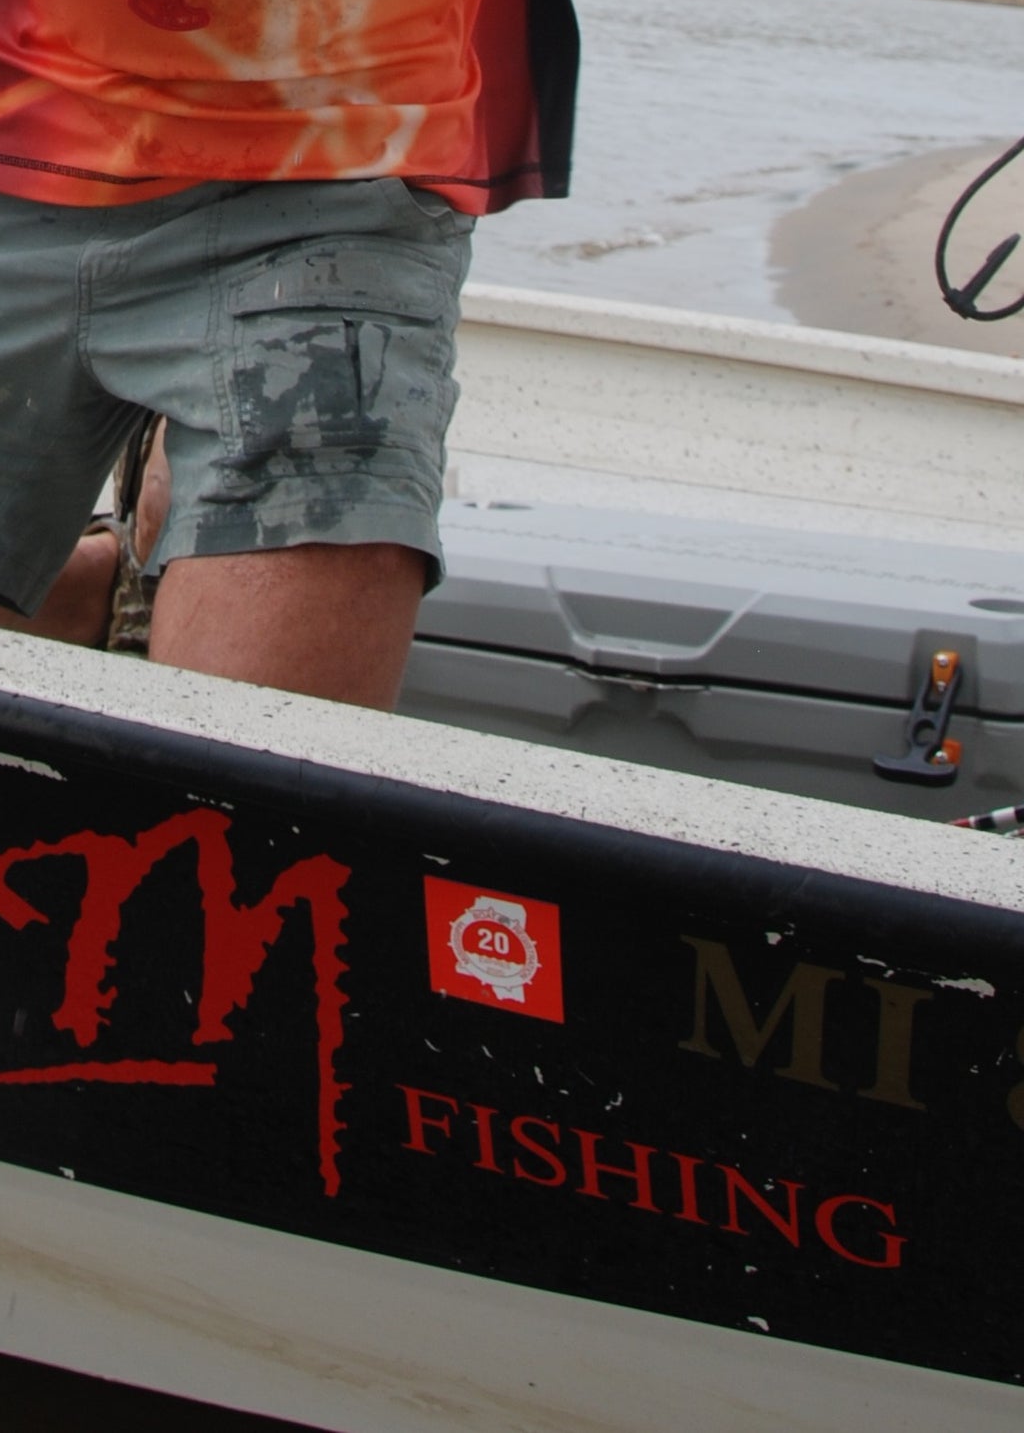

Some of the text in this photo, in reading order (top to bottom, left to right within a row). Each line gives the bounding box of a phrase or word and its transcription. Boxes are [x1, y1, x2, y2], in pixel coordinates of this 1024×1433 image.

[477, 927, 510, 955] 20
[677, 932, 935, 1113] MI
[394, 1083, 909, 1270] FISHING
